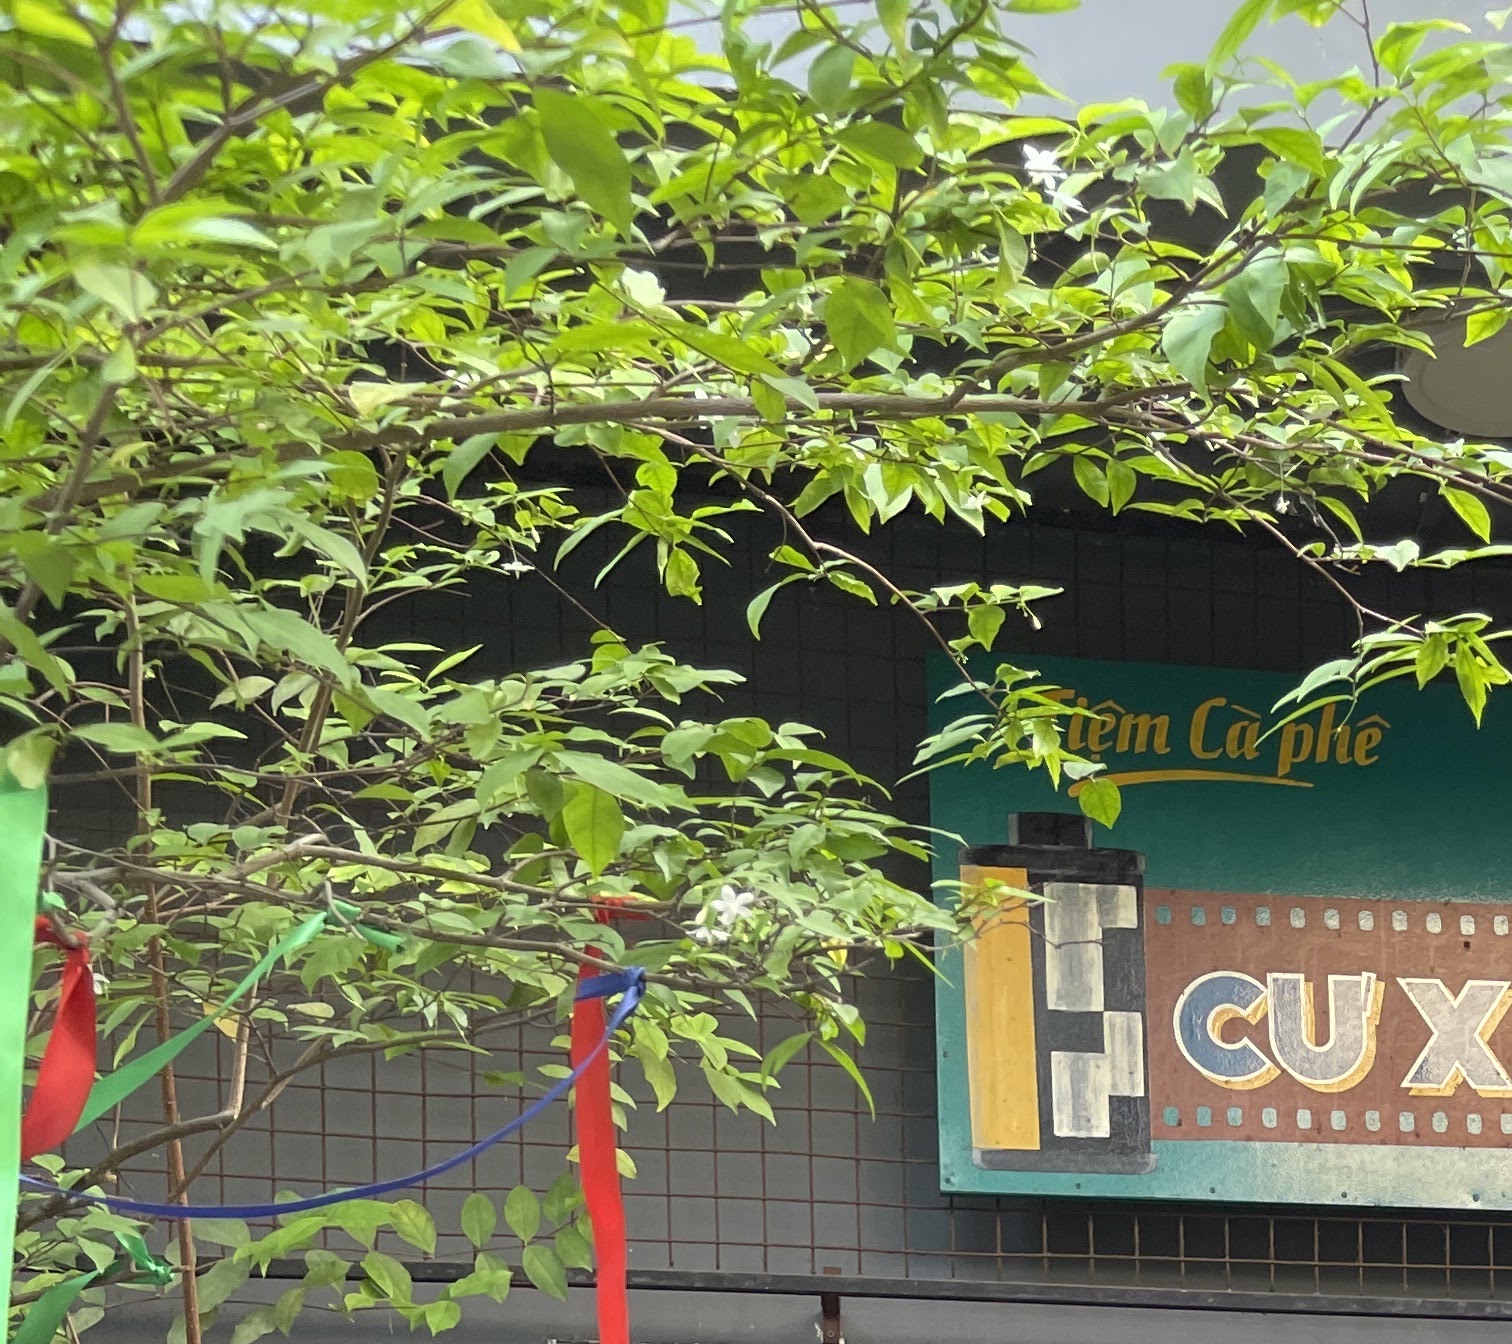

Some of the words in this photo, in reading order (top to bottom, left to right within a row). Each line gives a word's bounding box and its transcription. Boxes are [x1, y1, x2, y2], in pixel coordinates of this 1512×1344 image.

[1189, 697, 1262, 758] Cà
[1277, 702, 1391, 777] phê
[1173, 970, 1386, 1094] CƯ
